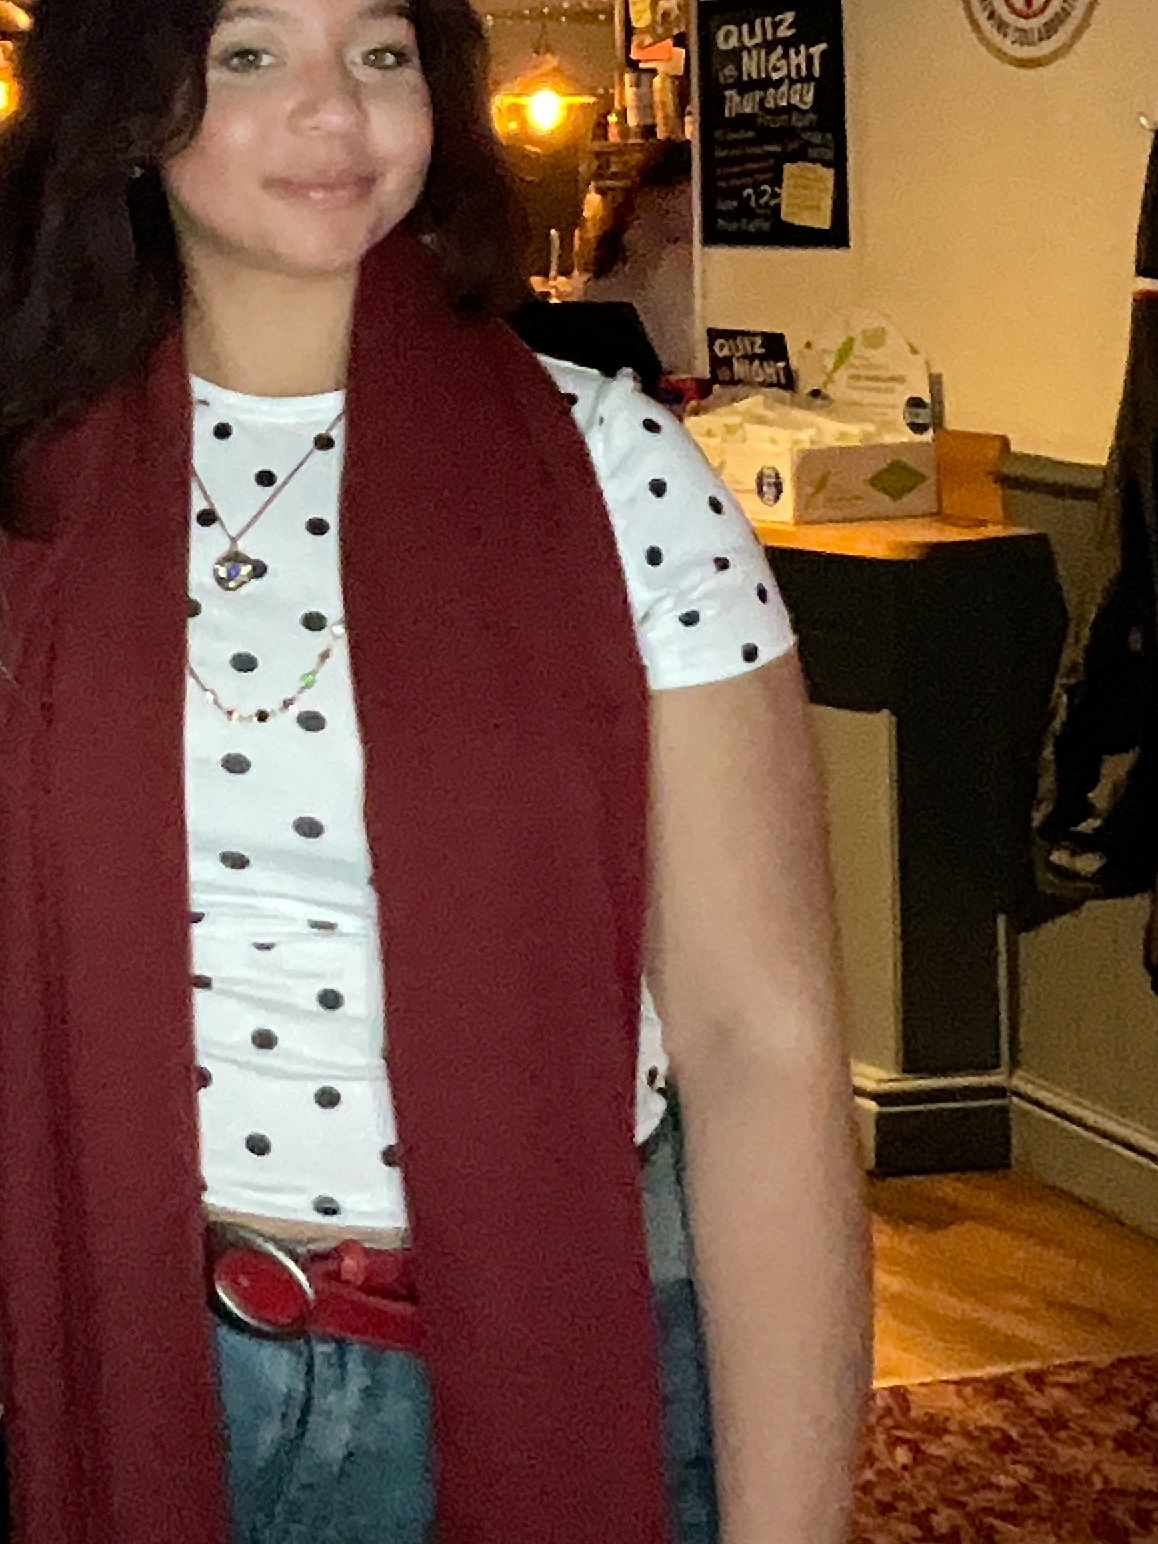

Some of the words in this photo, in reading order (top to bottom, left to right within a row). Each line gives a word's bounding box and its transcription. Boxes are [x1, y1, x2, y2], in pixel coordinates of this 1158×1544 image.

[716, 11, 796, 49] QUIZ
[742, 43, 829, 81] NIGHT
[713, 336, 765, 357] QUIZ
[732, 357, 786, 384] NIGHT
